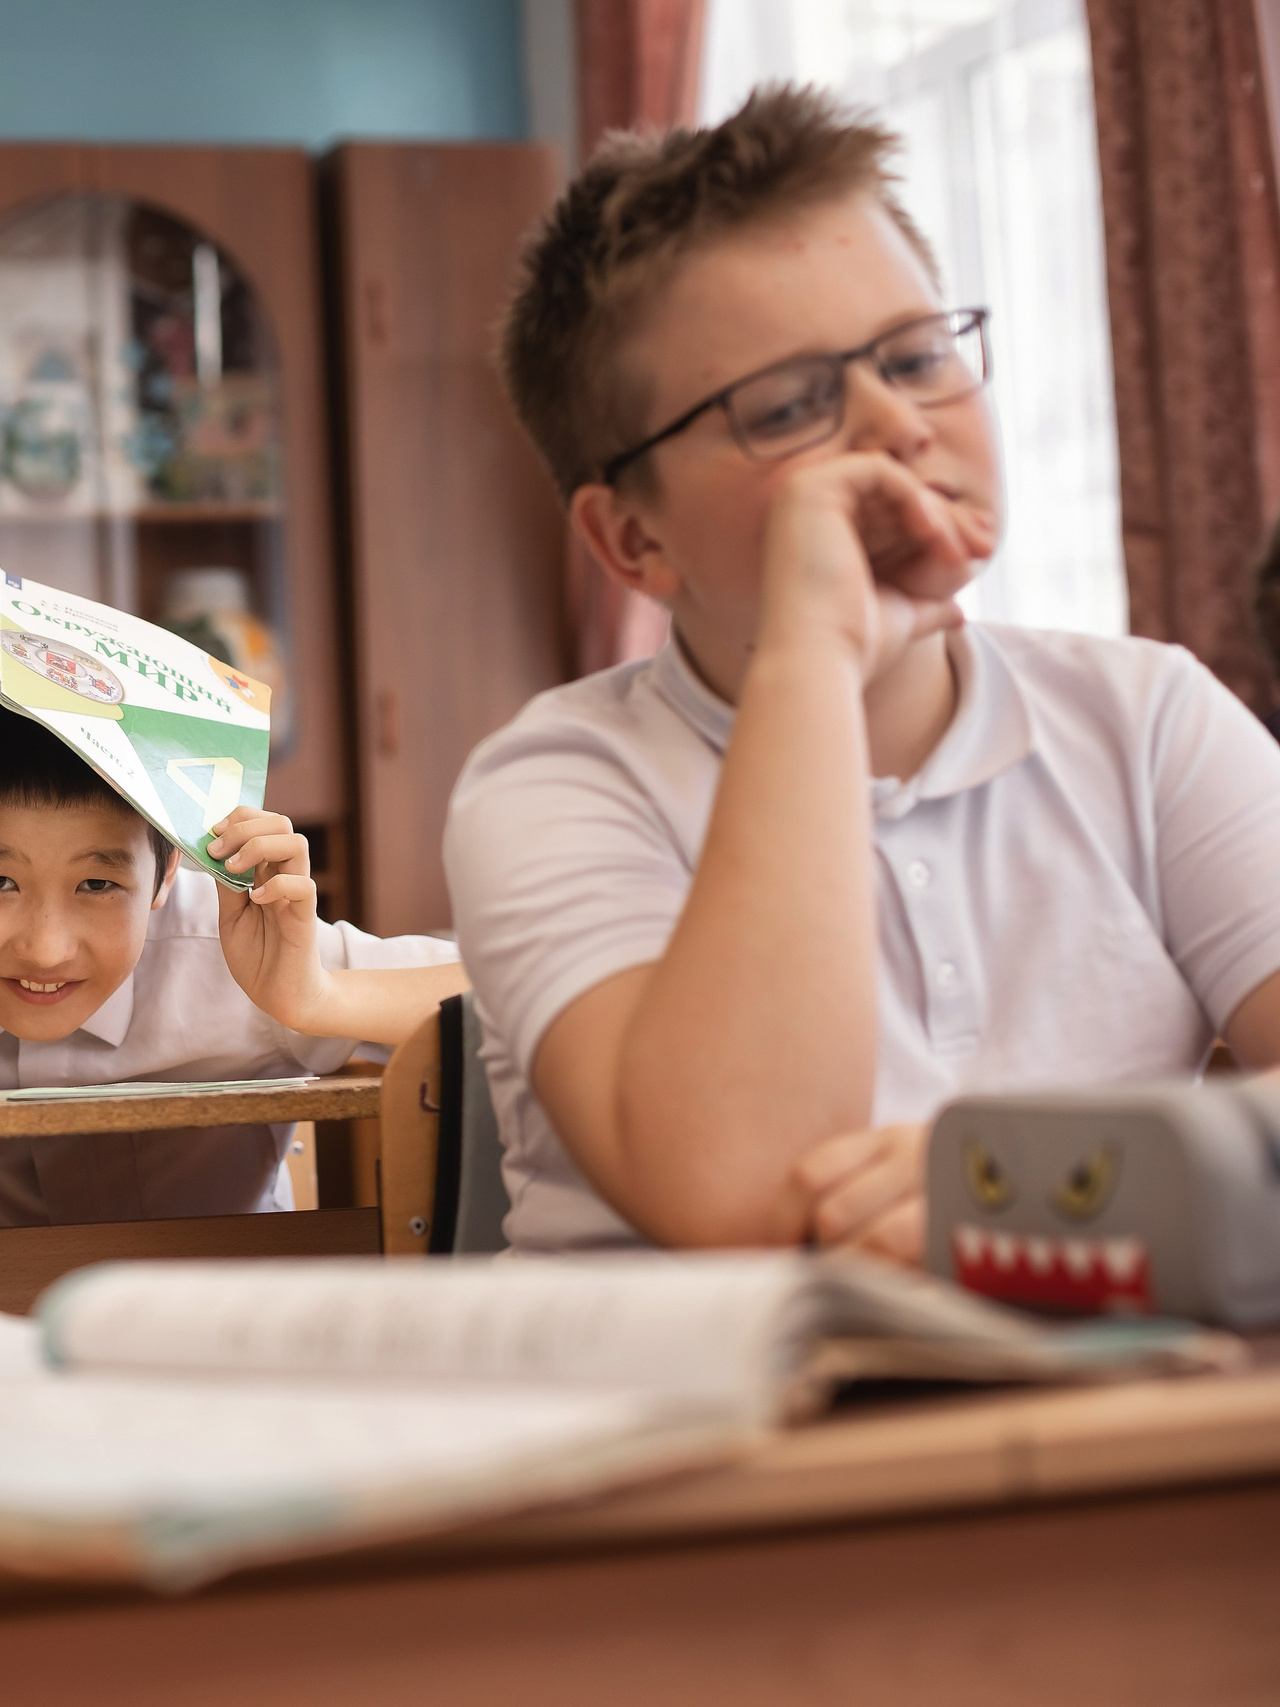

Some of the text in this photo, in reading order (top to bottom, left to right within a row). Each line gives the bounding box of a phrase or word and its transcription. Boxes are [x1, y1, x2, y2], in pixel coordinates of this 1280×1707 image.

[11, 600, 232, 715] Окружающий
[92, 639, 200, 704] МИР
[79, 725, 137, 780] Часть 2
[165, 756, 244, 839] 4
